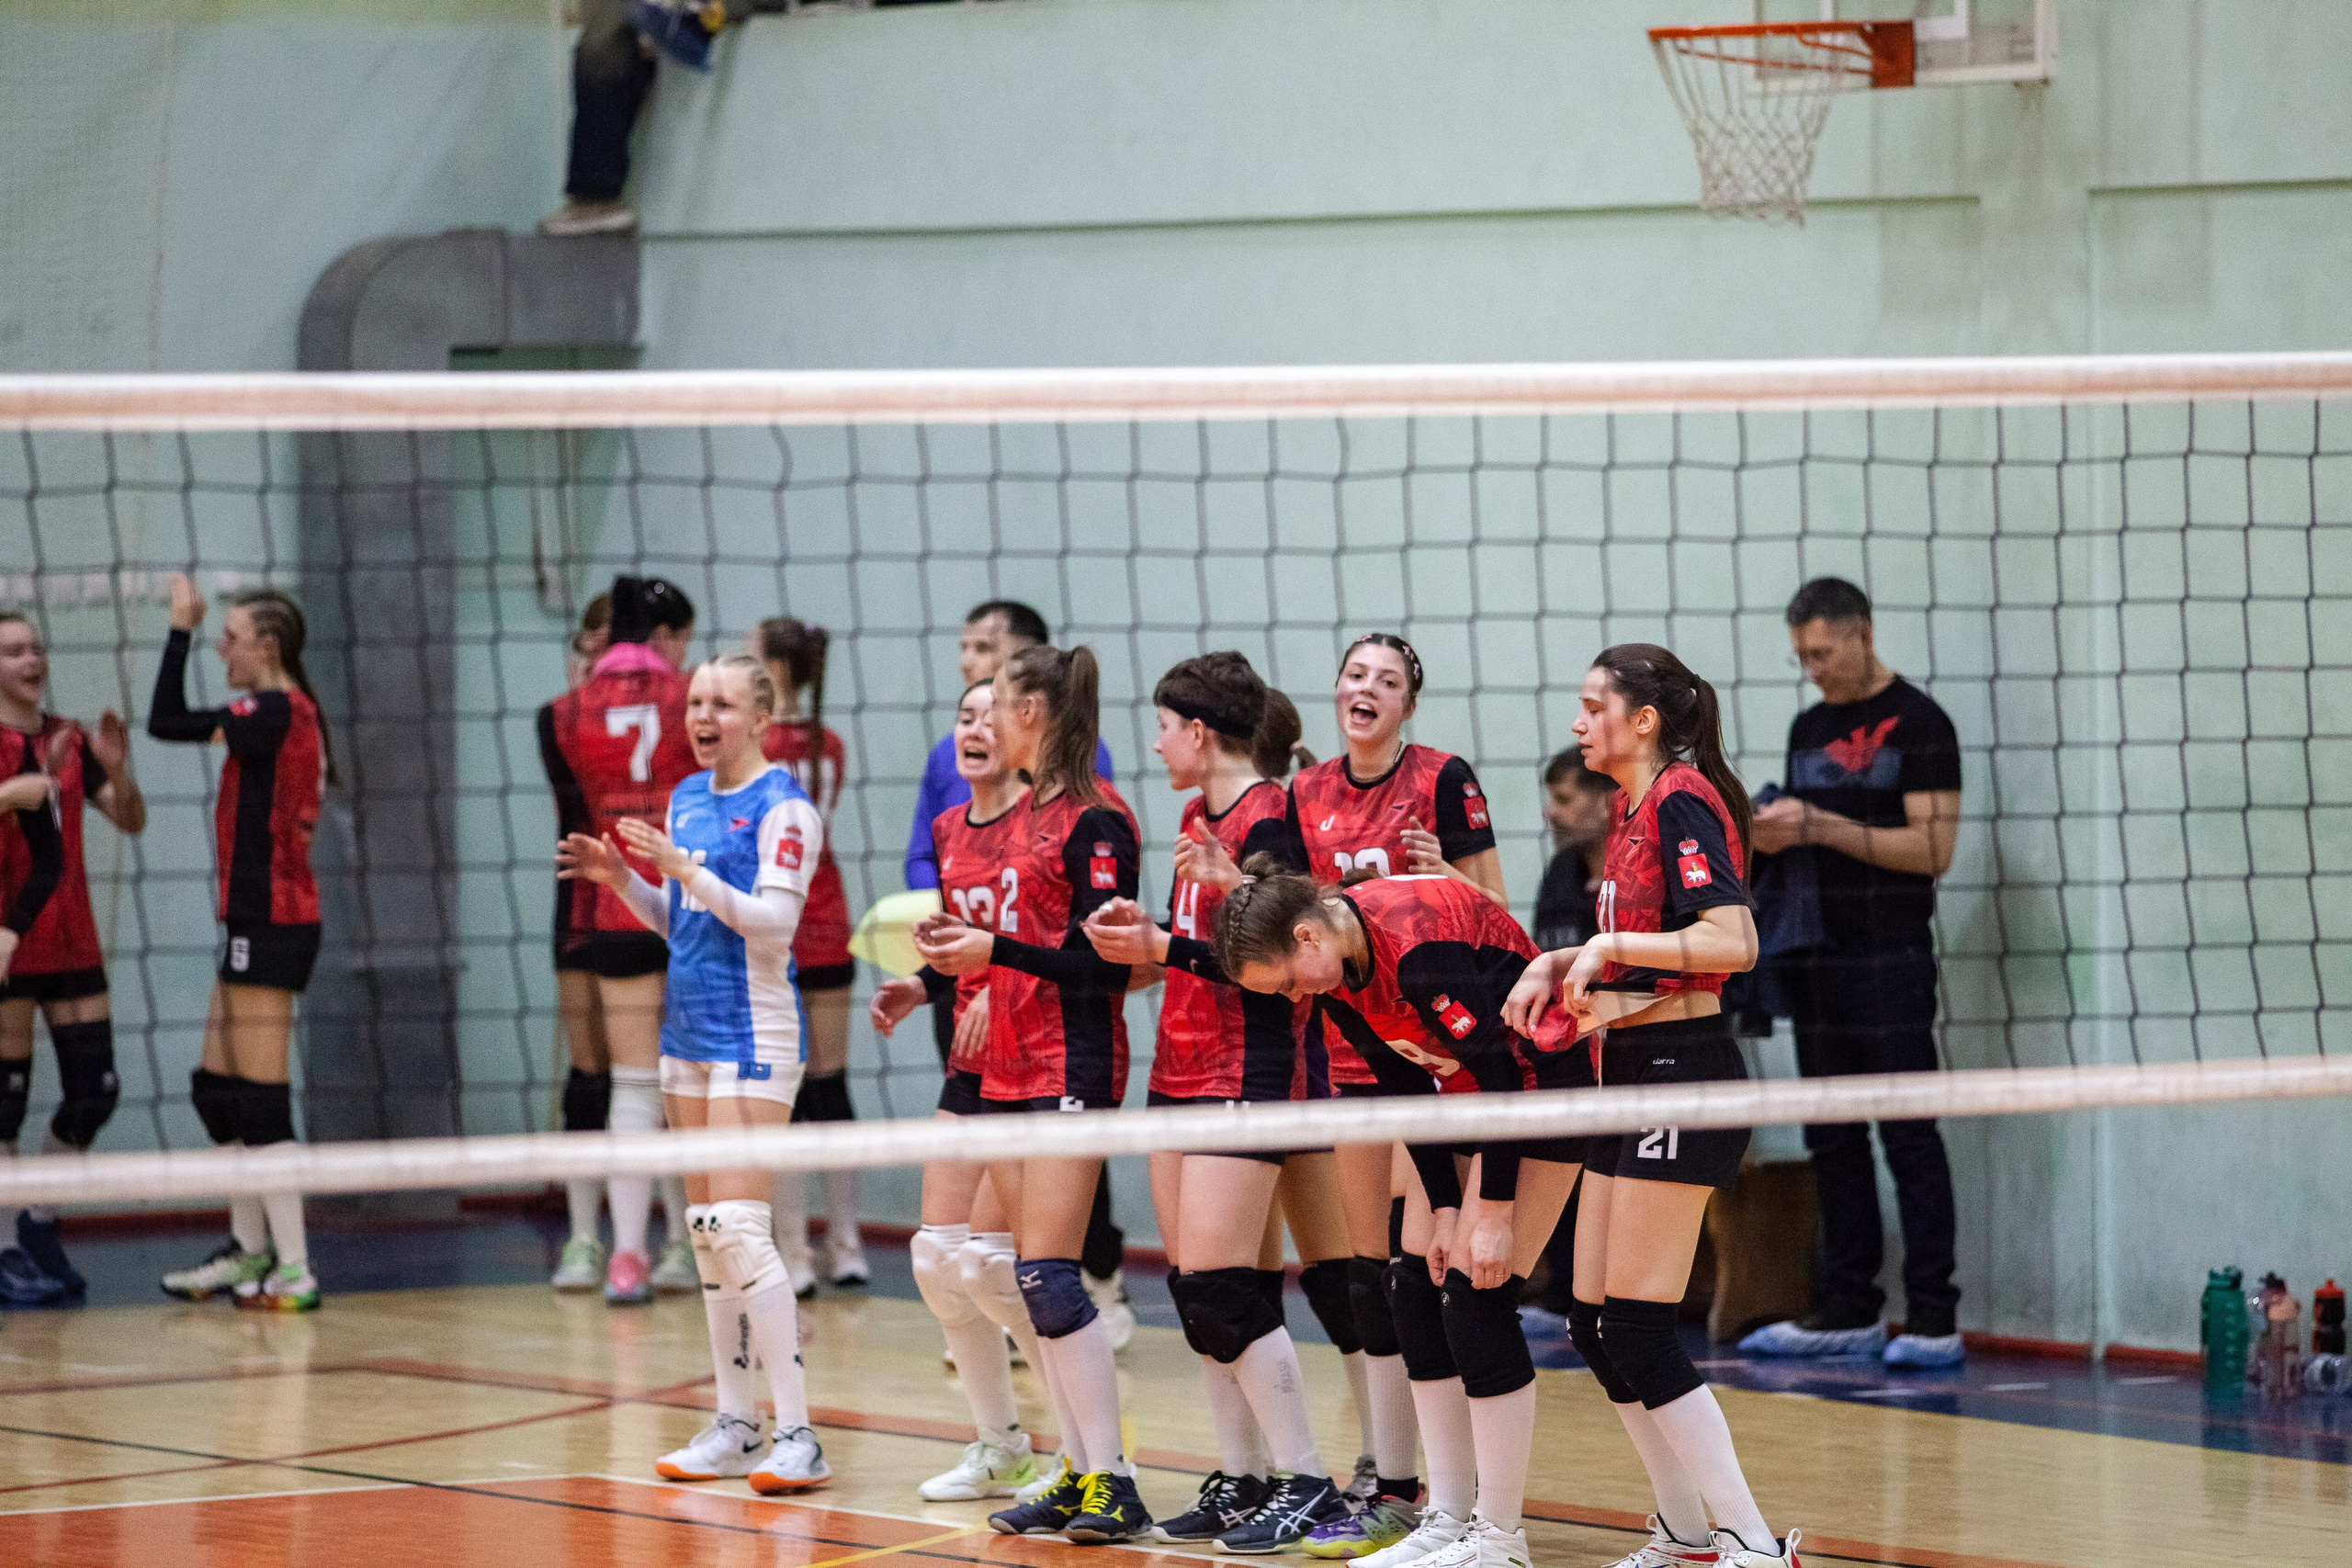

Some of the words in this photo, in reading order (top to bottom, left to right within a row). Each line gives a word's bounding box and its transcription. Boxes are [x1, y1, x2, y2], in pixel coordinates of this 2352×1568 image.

[605, 703, 662, 783] 7
[1000, 867, 1018, 933] 2
[1177, 878, 1200, 941] 4
[1637, 1121, 1679, 1159] 21
